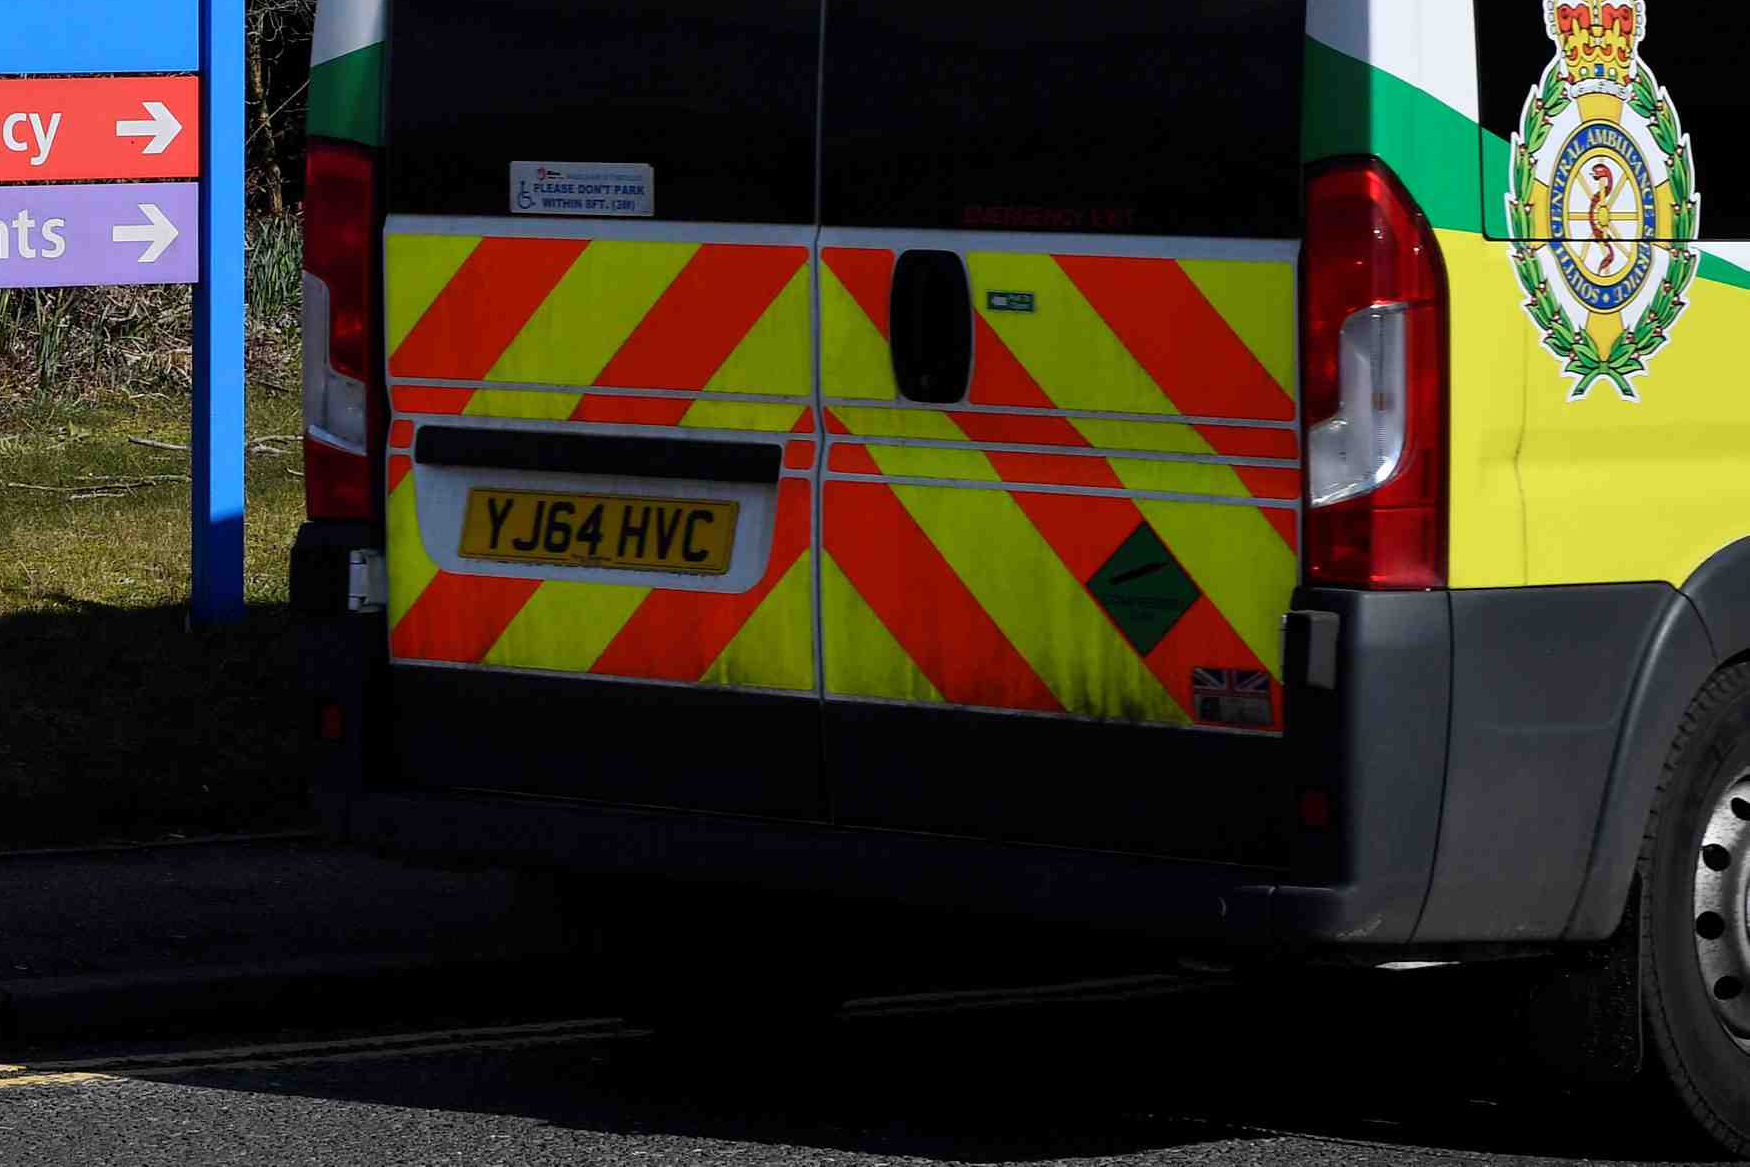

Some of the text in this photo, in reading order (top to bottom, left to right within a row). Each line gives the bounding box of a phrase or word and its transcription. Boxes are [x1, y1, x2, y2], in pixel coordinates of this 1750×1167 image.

[533, 183, 645, 195] PLEASE DON'T PARK
[542, 199, 583, 209] WITHIN
[487, 496, 714, 563] YJ64 HVC
